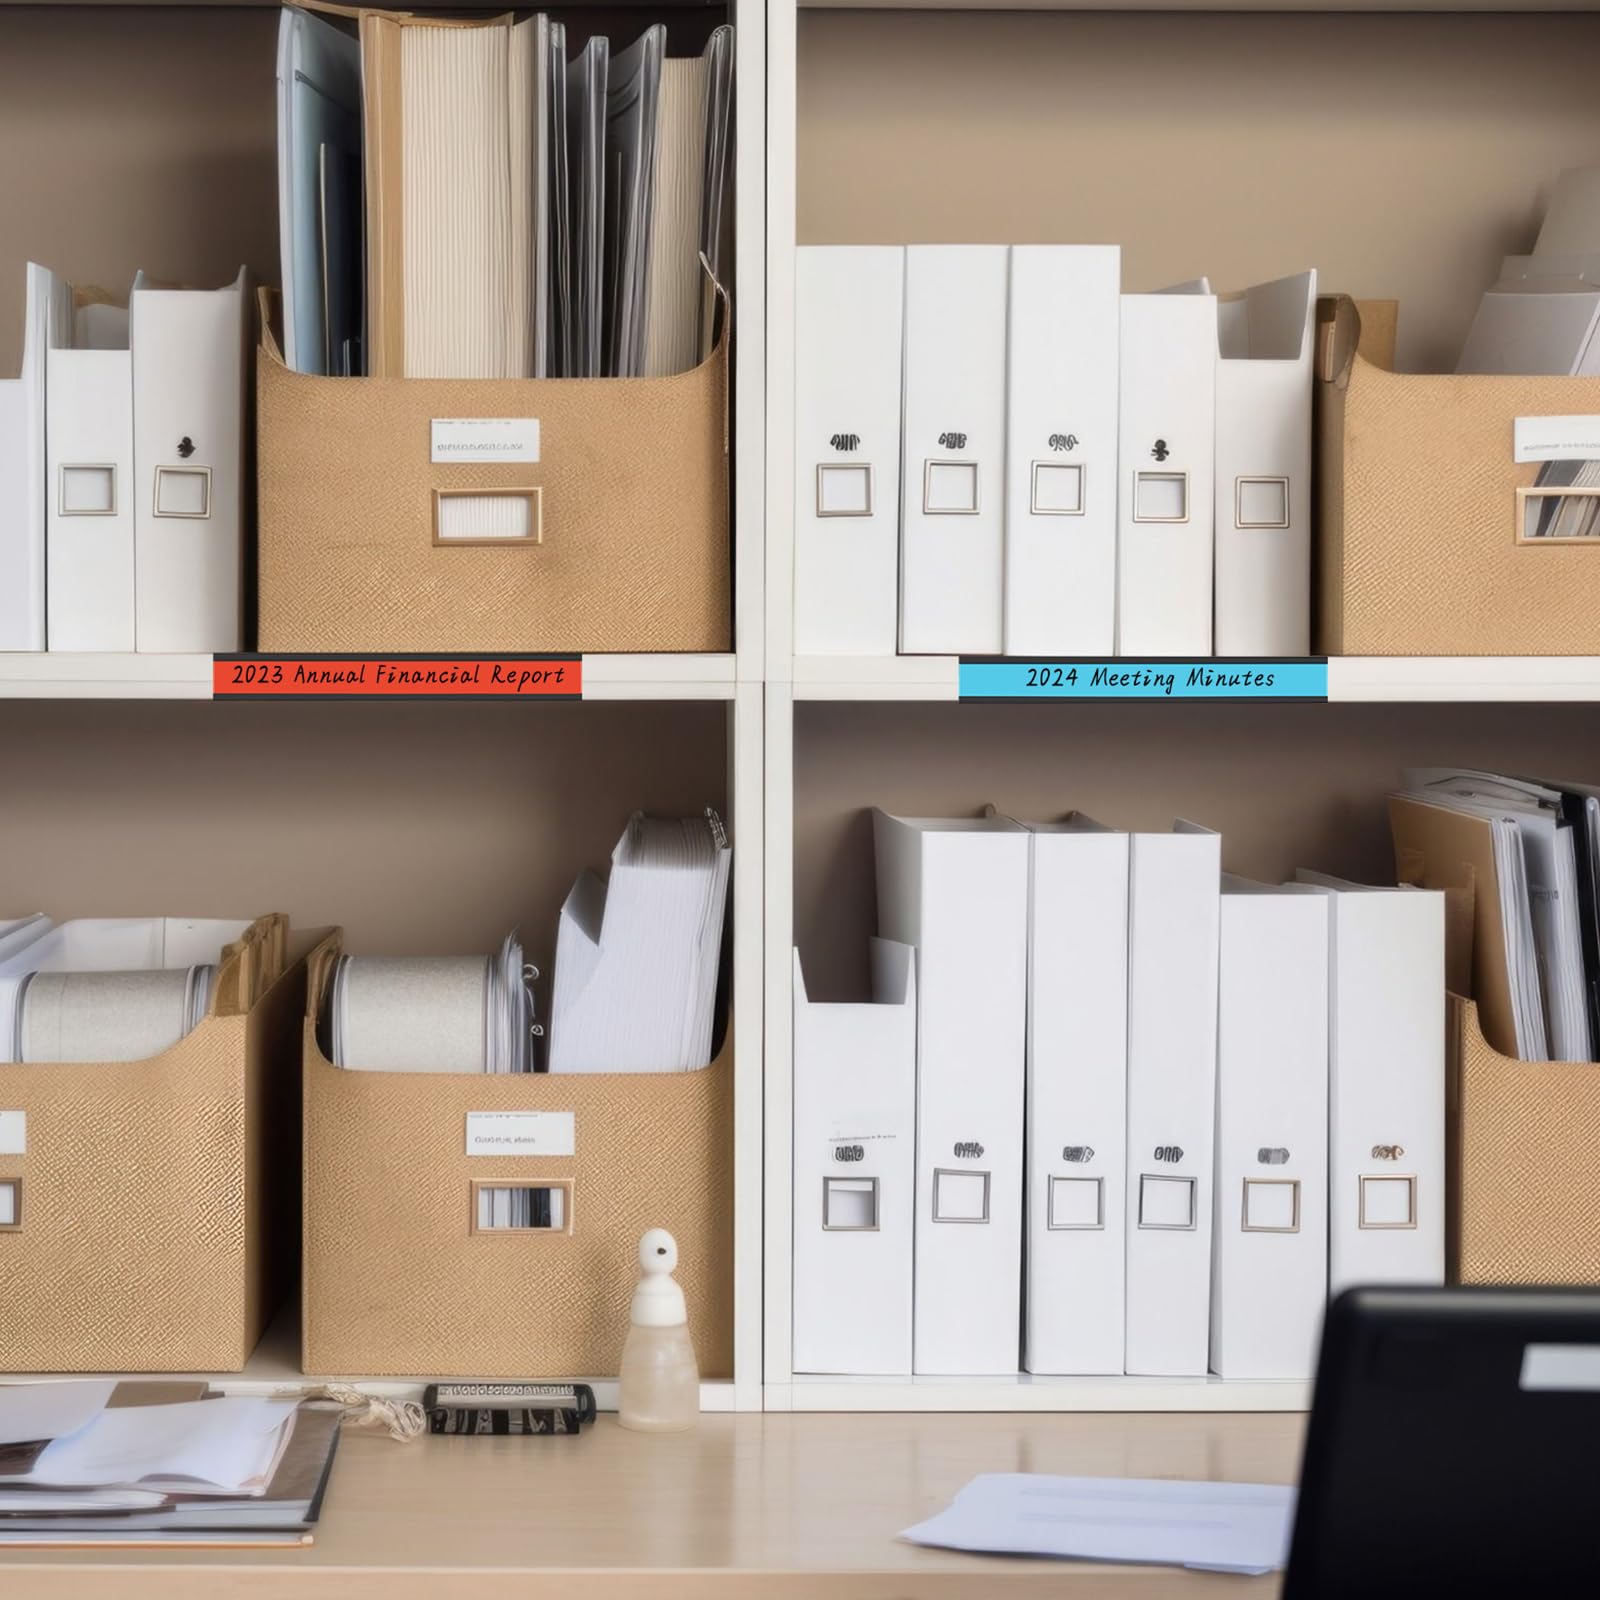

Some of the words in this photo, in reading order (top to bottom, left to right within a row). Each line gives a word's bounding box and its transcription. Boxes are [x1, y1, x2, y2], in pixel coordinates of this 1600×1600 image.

[232, 664, 283, 684] 2023
[294, 664, 365, 684] Annual
[376, 664, 480, 684] Financial
[491, 664, 564, 692] Report
[1026, 667, 1078, 687] 2024
[1090, 667, 1175, 695] Meeting
[1186, 667, 1274, 687] Minutes
